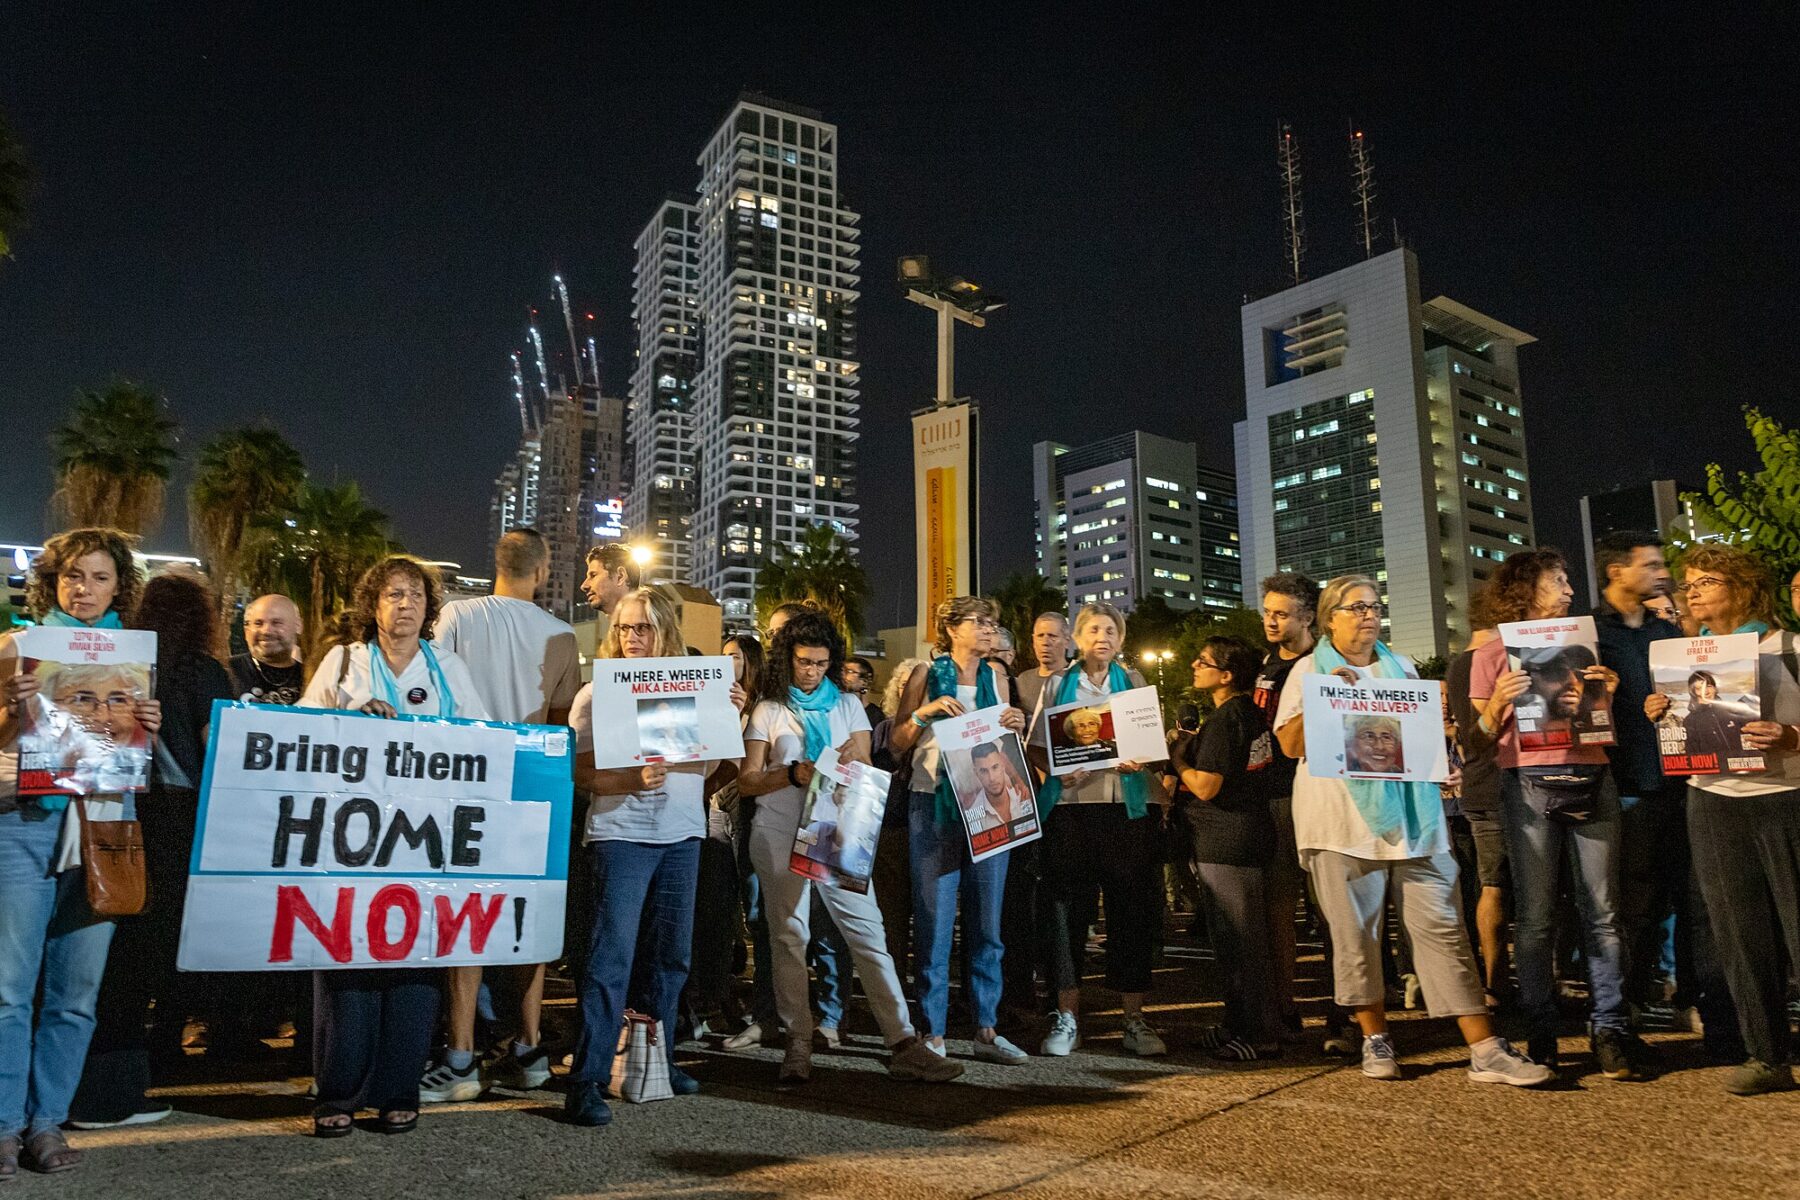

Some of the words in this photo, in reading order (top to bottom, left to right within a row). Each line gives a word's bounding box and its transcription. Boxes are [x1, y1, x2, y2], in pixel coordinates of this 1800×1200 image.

[1686, 647, 1703, 656] EFRAT
[1704, 646, 1718, 654] KATZ
[614, 671, 631, 683] I'M
[633, 670, 667, 682] HERE.
[668, 669, 710, 681] WHERE
[712, 668, 722, 680] IS
[631, 682, 660, 694] MIKA
[1320, 686, 1336, 698] I'M
[1338, 687, 1371, 700] HERE.
[1372, 689, 1416, 702] WHERE
[1417, 691, 1429, 702] IS
[1330, 699, 1368, 712] VIVIAN
[1659, 726, 1687, 741] BRING
[243, 731, 368, 783] Bring
[384, 740, 487, 782] them
[1663, 755, 1689, 769] HOME
[1690, 752, 1719, 769] NOW!
[965, 805, 986, 822] BRING
[271, 795, 486, 868] HOME
